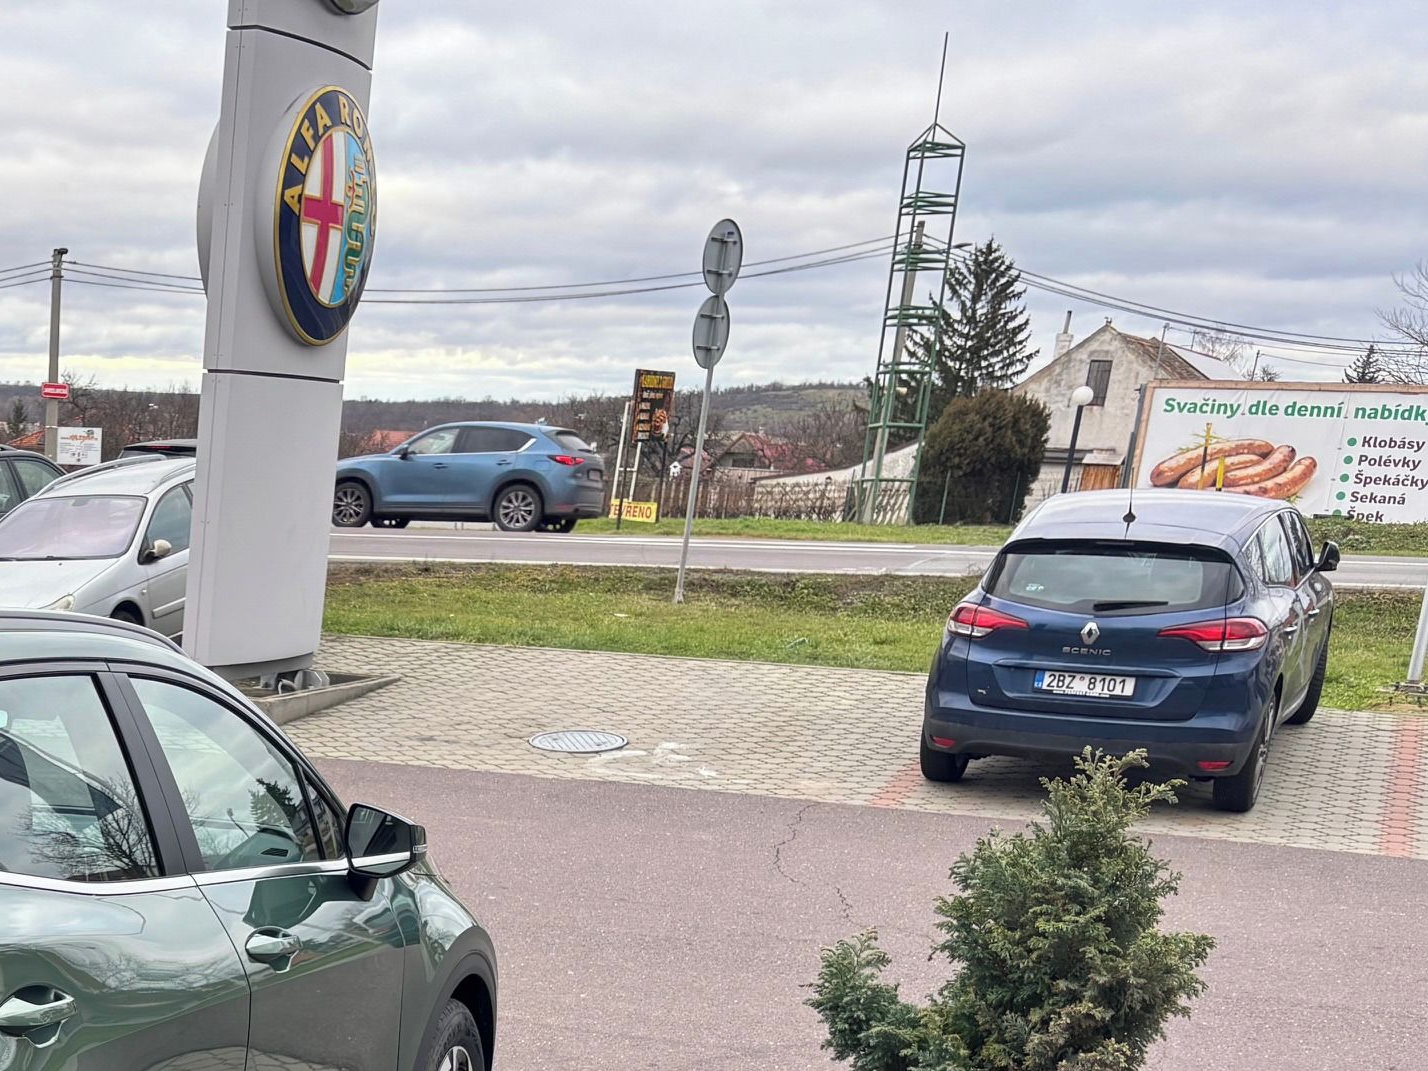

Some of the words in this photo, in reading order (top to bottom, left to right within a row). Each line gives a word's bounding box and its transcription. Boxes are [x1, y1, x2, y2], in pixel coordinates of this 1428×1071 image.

[283, 102, 332, 216] ALFA
[1163, 397, 1243, 419] Svačiny
[1248, 400, 1280, 416] dle
[1284, 400, 1346, 419] denní
[1353, 404, 1428, 426] nabídk
[1362, 436, 1426, 453] Klobásy
[1358, 454, 1422, 471] Polévky
[1353, 469, 1428, 491] Špekáčky
[1350, 491, 1406, 506] Sekaná
[1062, 646, 1112, 656] SCENIC
[1046, 673, 1077, 690] 2BZ
[1087, 676, 1127, 694] 8101
